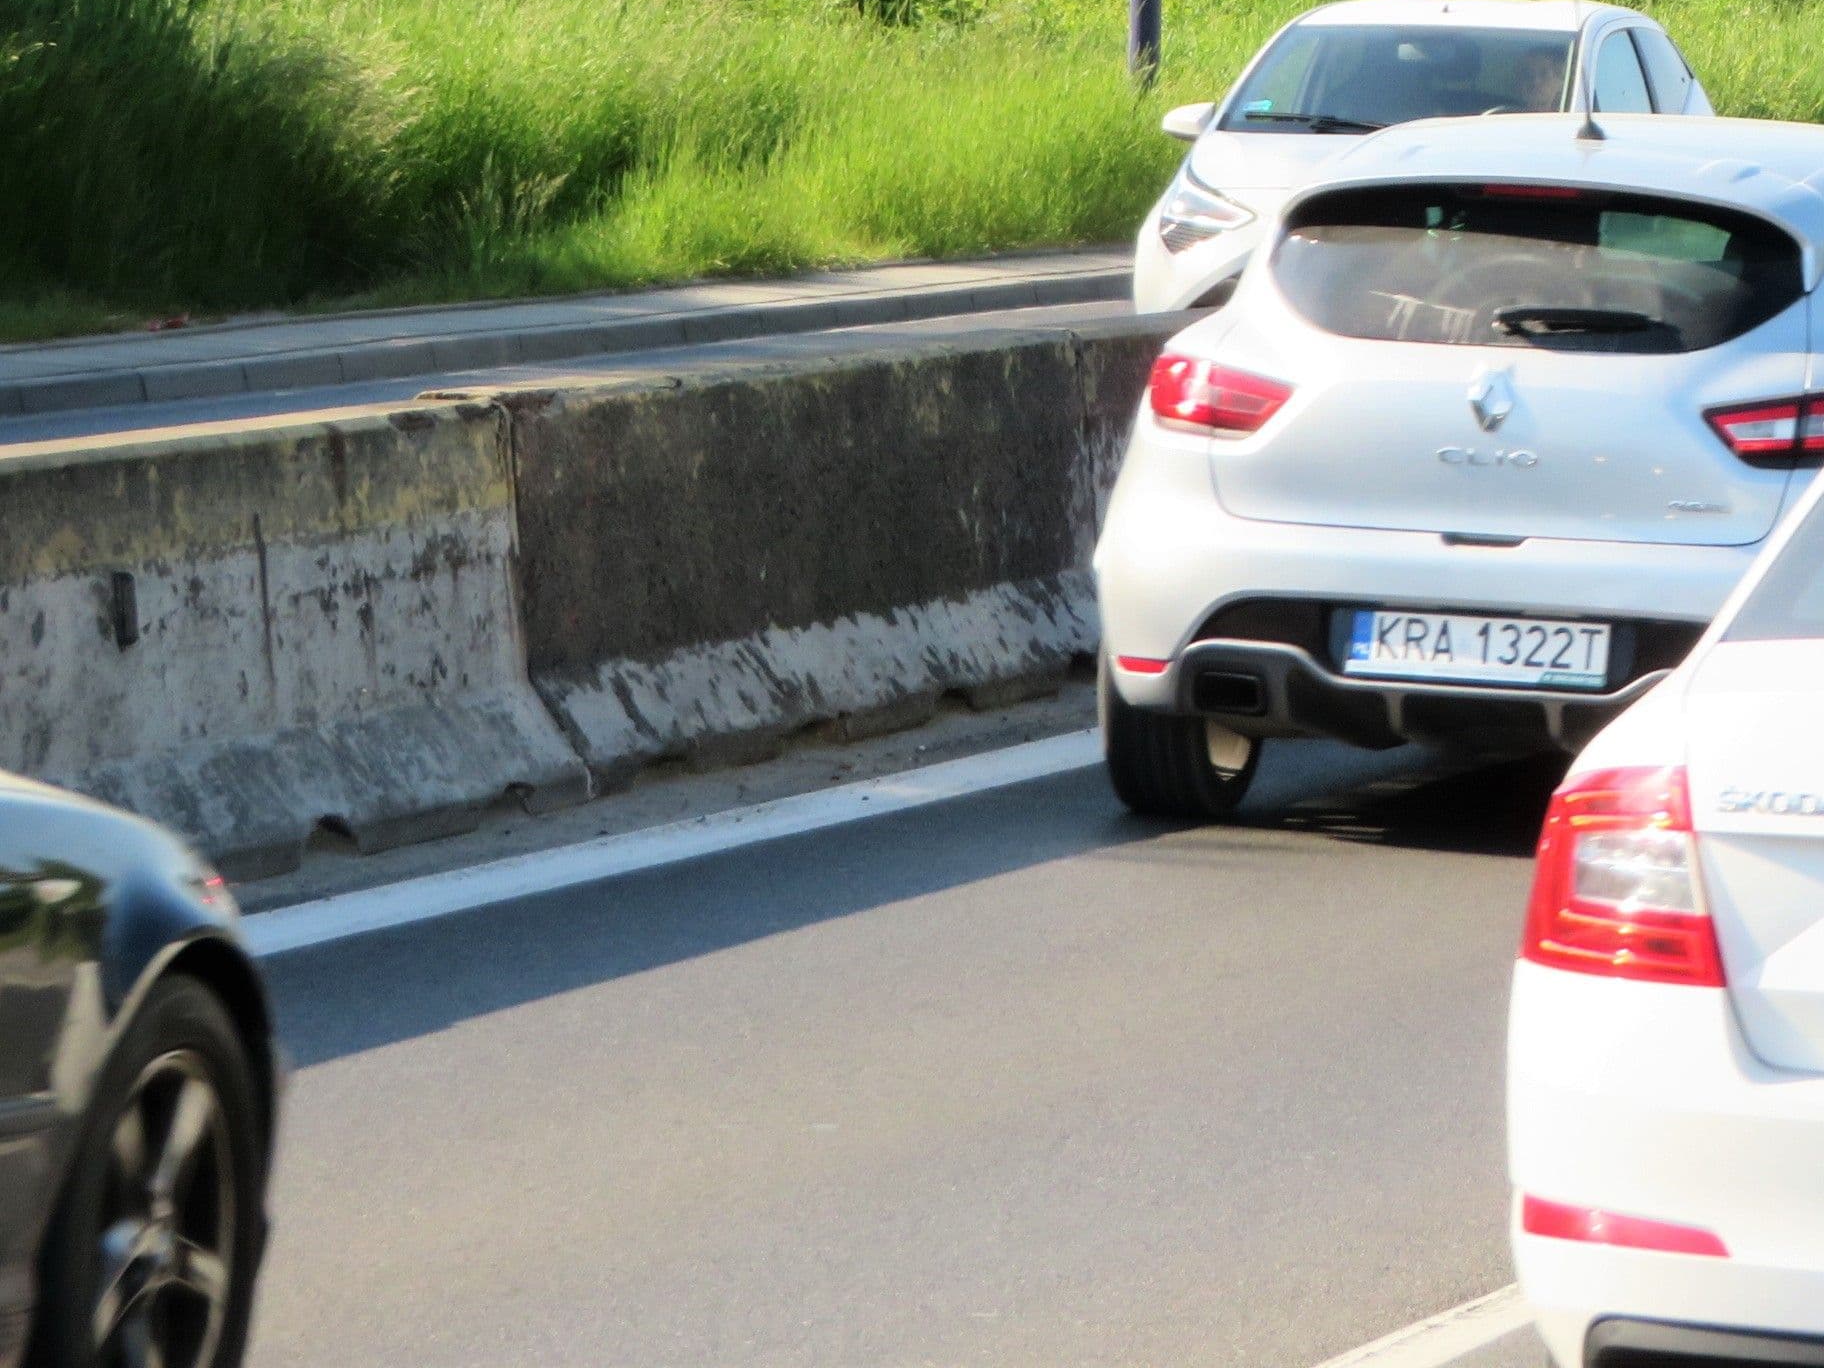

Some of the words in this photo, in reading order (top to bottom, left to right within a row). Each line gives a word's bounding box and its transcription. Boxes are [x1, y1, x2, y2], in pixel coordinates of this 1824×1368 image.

[1436, 445, 1538, 467] CLIO
[1376, 616, 1454, 664] KRA
[1478, 620, 1605, 671] 1322T
